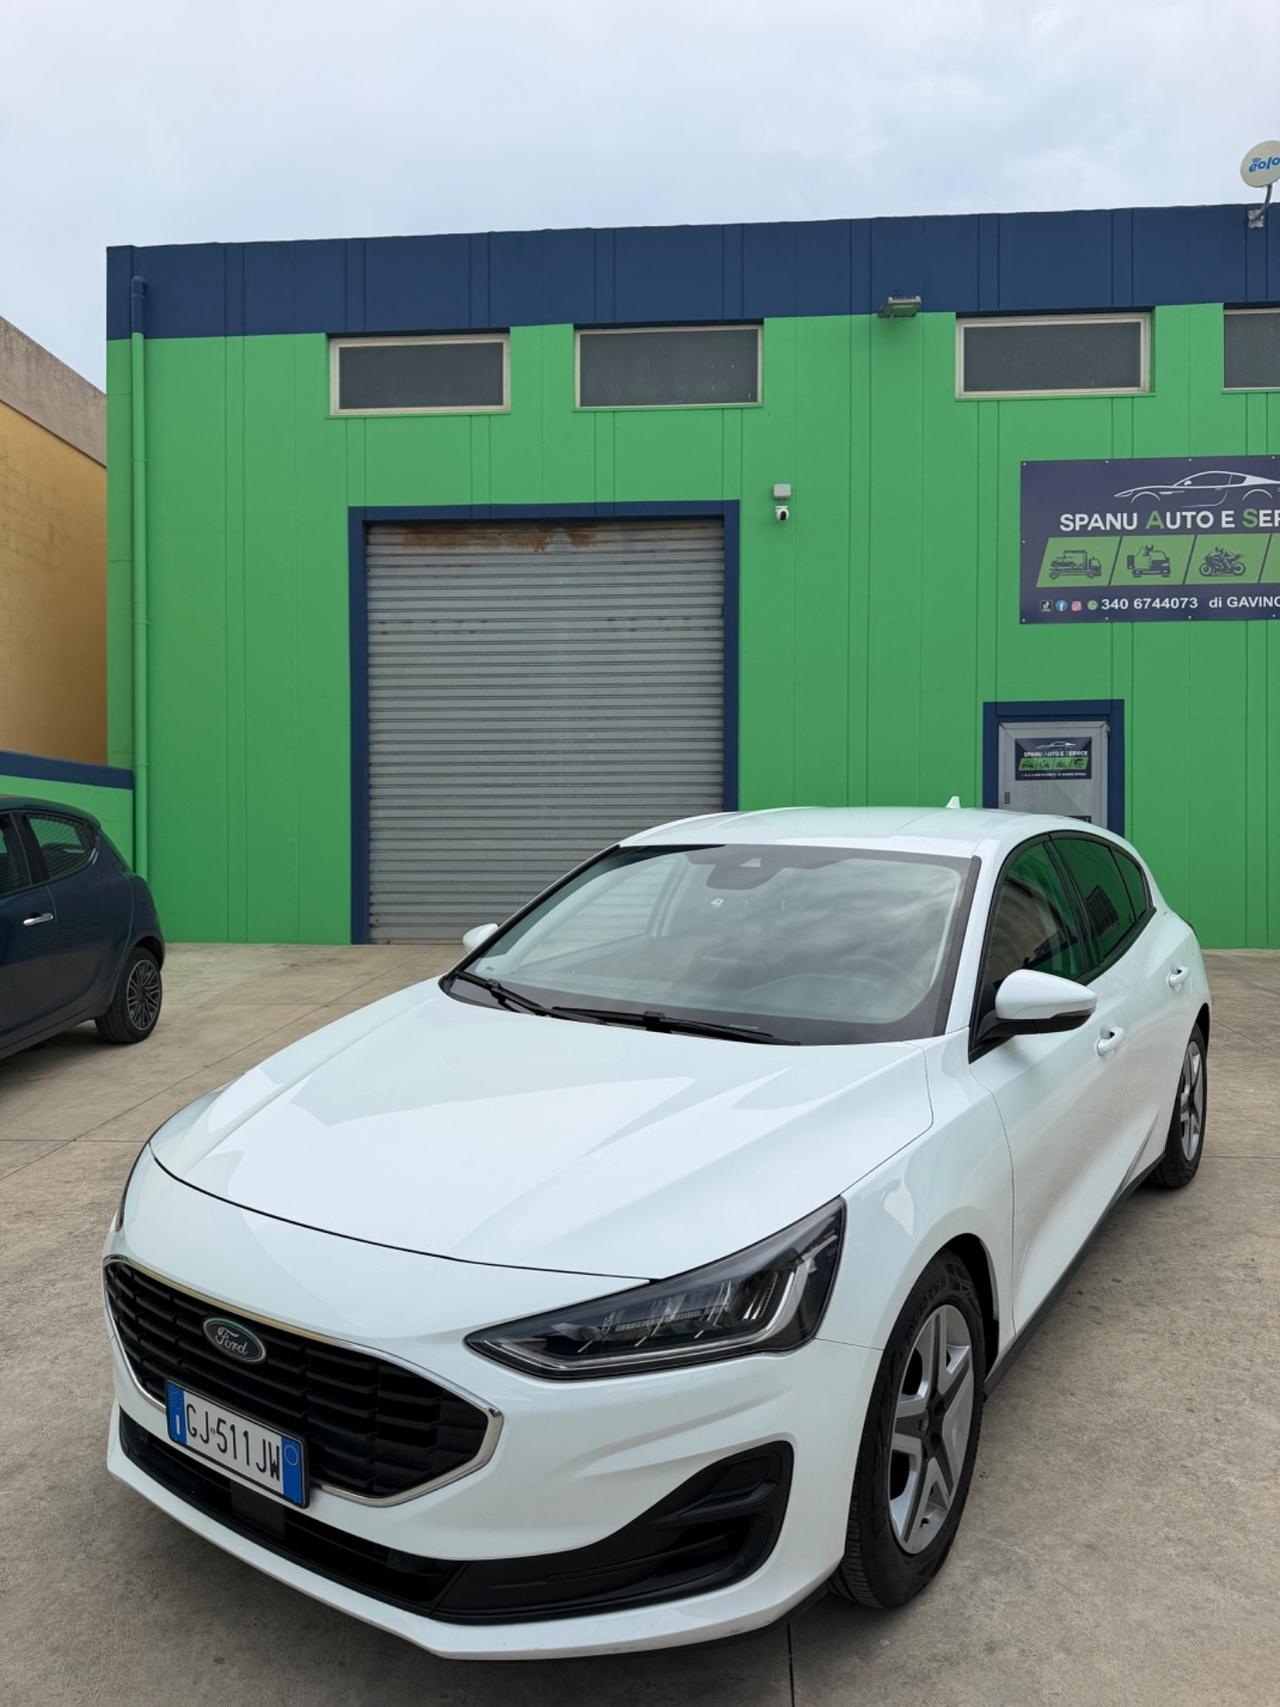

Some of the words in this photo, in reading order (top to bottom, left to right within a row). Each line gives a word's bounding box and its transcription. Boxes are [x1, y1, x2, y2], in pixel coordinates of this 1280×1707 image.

[1059, 512, 1138, 531] SPANU
[1145, 510, 1214, 529] AUTO
[1221, 510, 1235, 528] E
[1101, 598, 1129, 610] 340
[1133, 597, 1198, 610] 6744073
[1209, 596, 1222, 609] di
[214, 1326, 249, 1356] Ford
